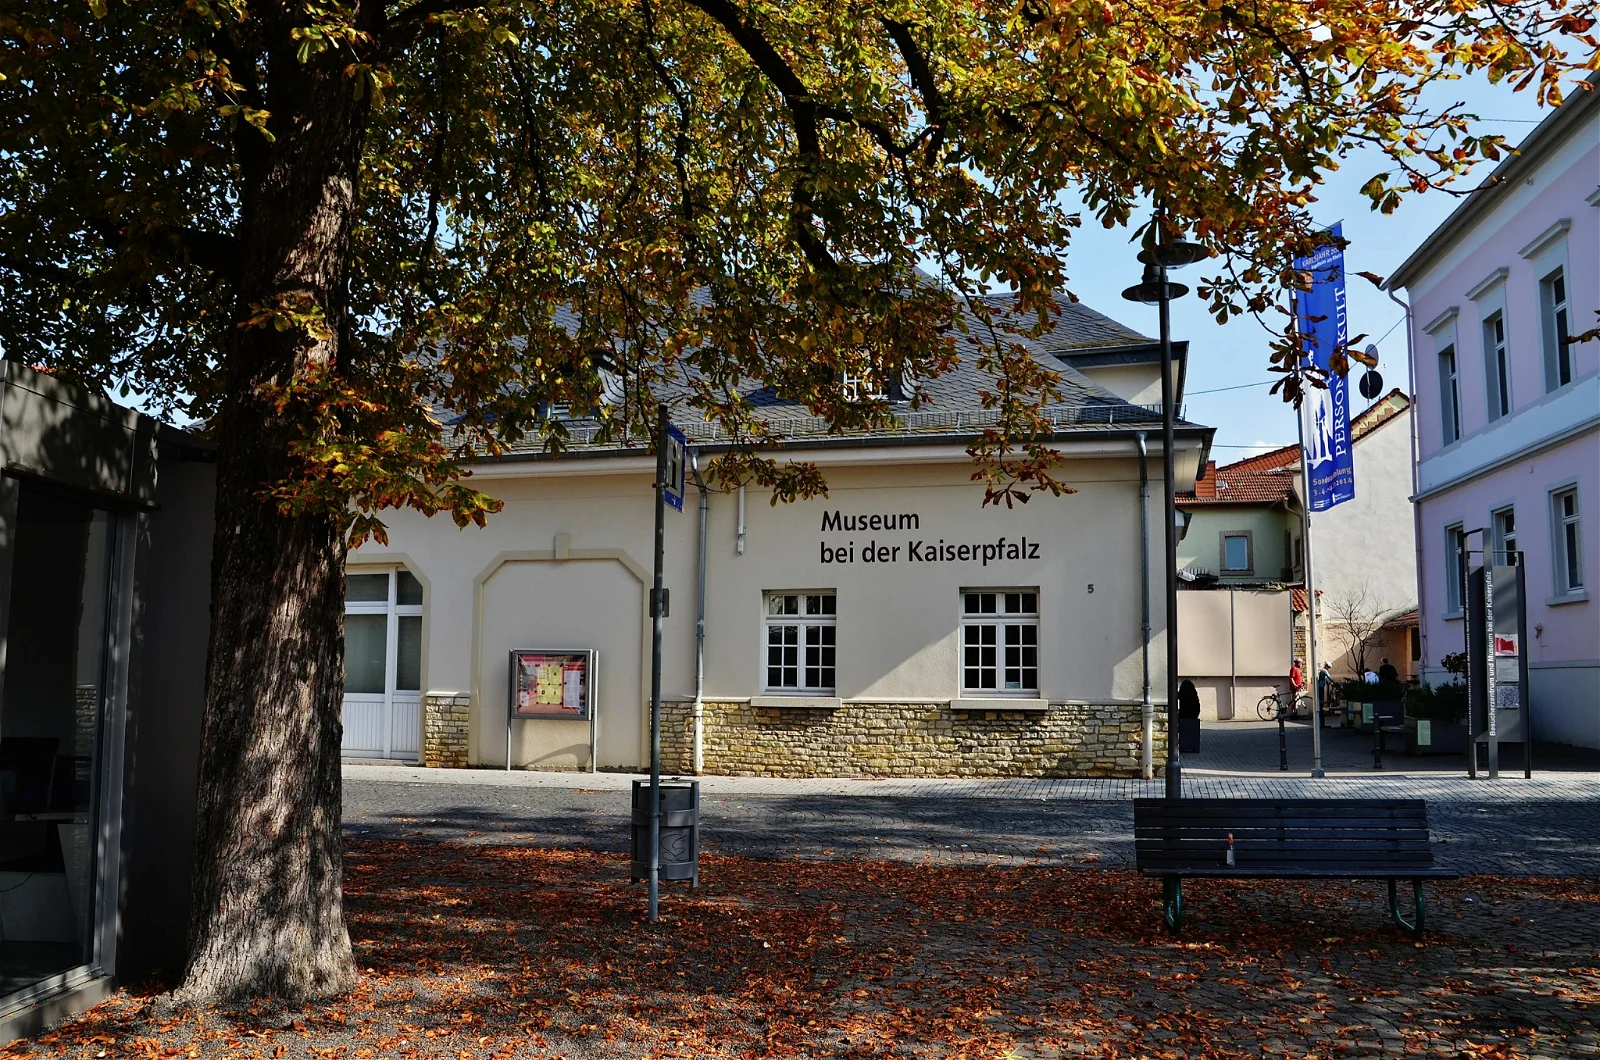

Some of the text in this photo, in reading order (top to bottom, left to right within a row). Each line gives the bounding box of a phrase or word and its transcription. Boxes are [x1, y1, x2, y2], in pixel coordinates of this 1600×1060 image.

[1334, 287, 1347, 457] PERSONKULT
[820, 510, 920, 532] Museum
[820, 536, 1041, 567] bei der Kaiserpfalz
[1087, 583, 1095, 594] 5
[1485, 571, 1494, 608] Kaiserpfalz
[1487, 633, 1495, 662] Museum
